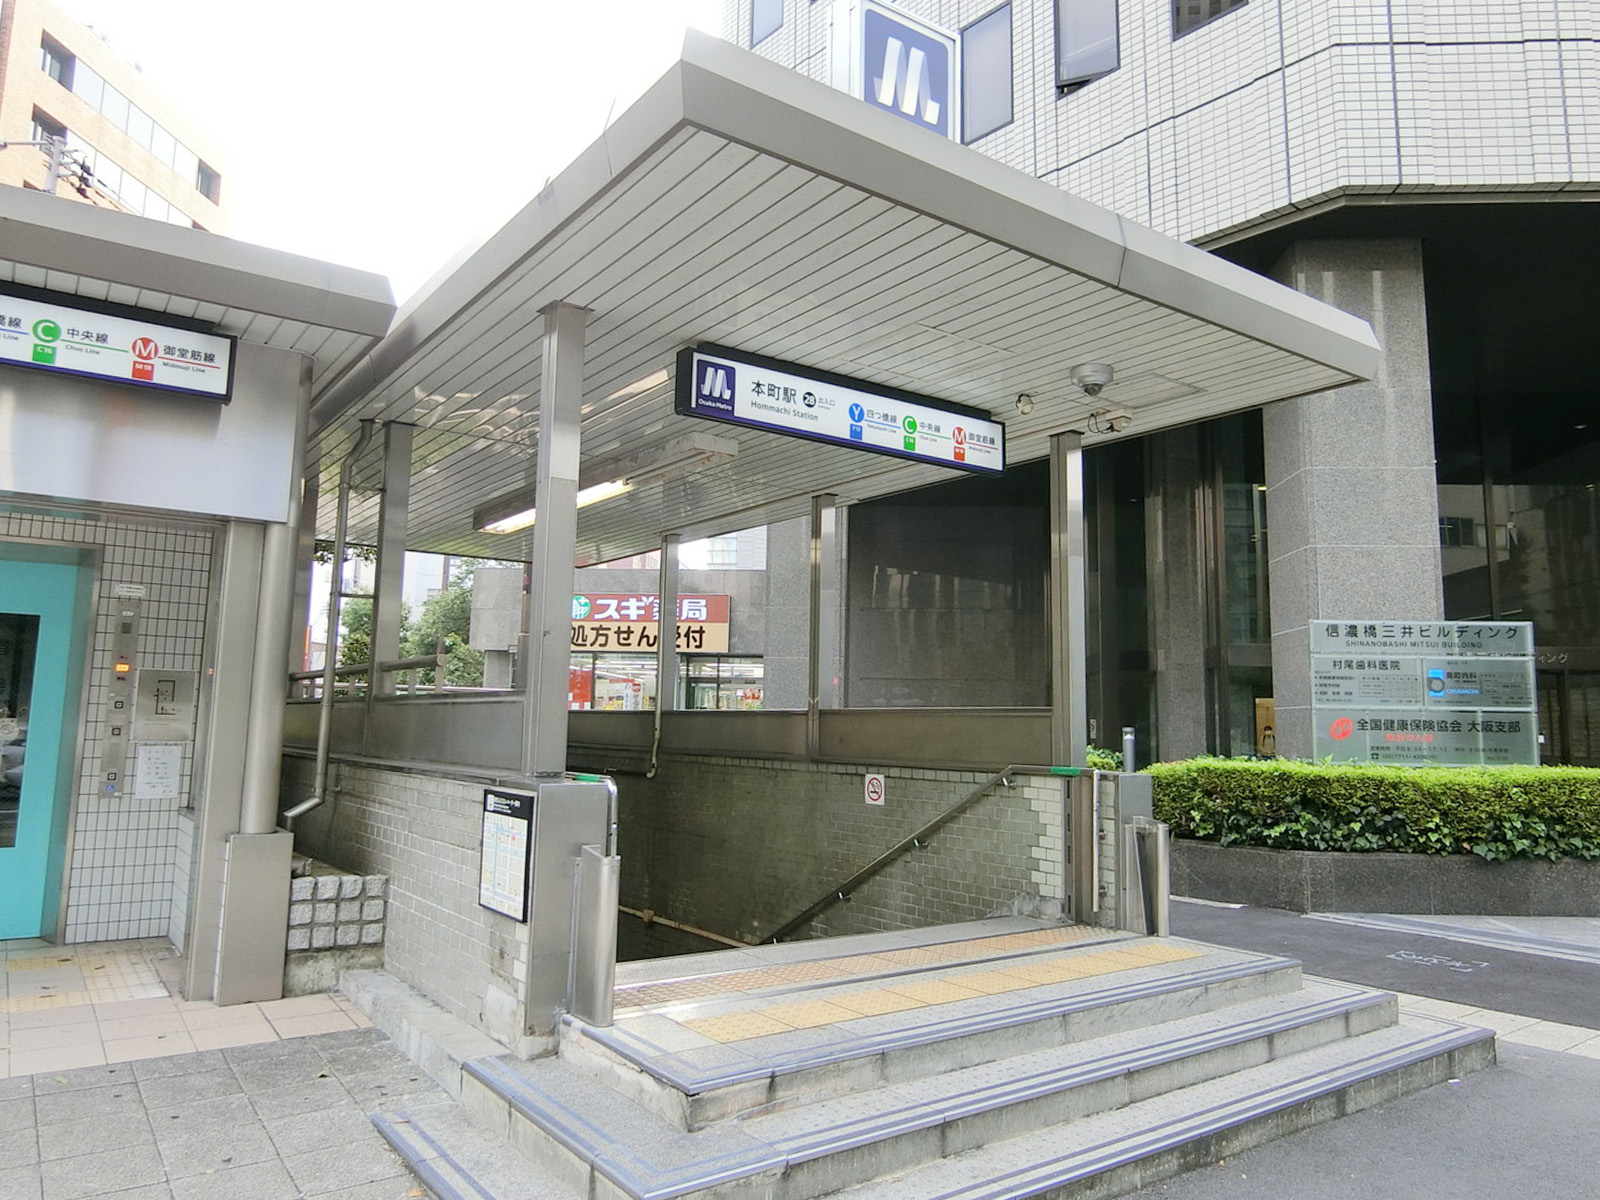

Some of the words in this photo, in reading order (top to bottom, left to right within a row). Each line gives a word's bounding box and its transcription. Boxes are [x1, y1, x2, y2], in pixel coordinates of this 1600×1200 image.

[36, 321, 55, 341] C
[66, 327, 109, 344] 中央線
[65, 344, 84, 352] Chuo
[85, 347, 101, 355] Line
[134, 339, 156, 359] M
[163, 344, 216, 364] 御堂筋線
[751, 380, 797, 405] 本町駅
[803, 393, 816, 407] 28
[716, 402, 733, 411] Metro
[751, 400, 791, 415] Hommachi
[792, 409, 819, 422] Station
[866, 409, 898, 424] 四つ橋線
[919, 421, 941, 433] 中央線
[593, 595, 707, 621] スギ局
[570, 624, 706, 649] 処方せん付
[1325, 624, 1519, 640] 信濃橋三井ビルディング
[1345, 640, 1407, 648] SHINANOBASHI
[1410, 641, 1439, 649] MITSUI
[1441, 641, 1483, 649] BUILDING
[1333, 659, 1401, 671] 村尾歯科医院
[1356, 718, 1463, 733] 全国健康保険協会
[1467, 720, 1521, 733] 大阪支部
